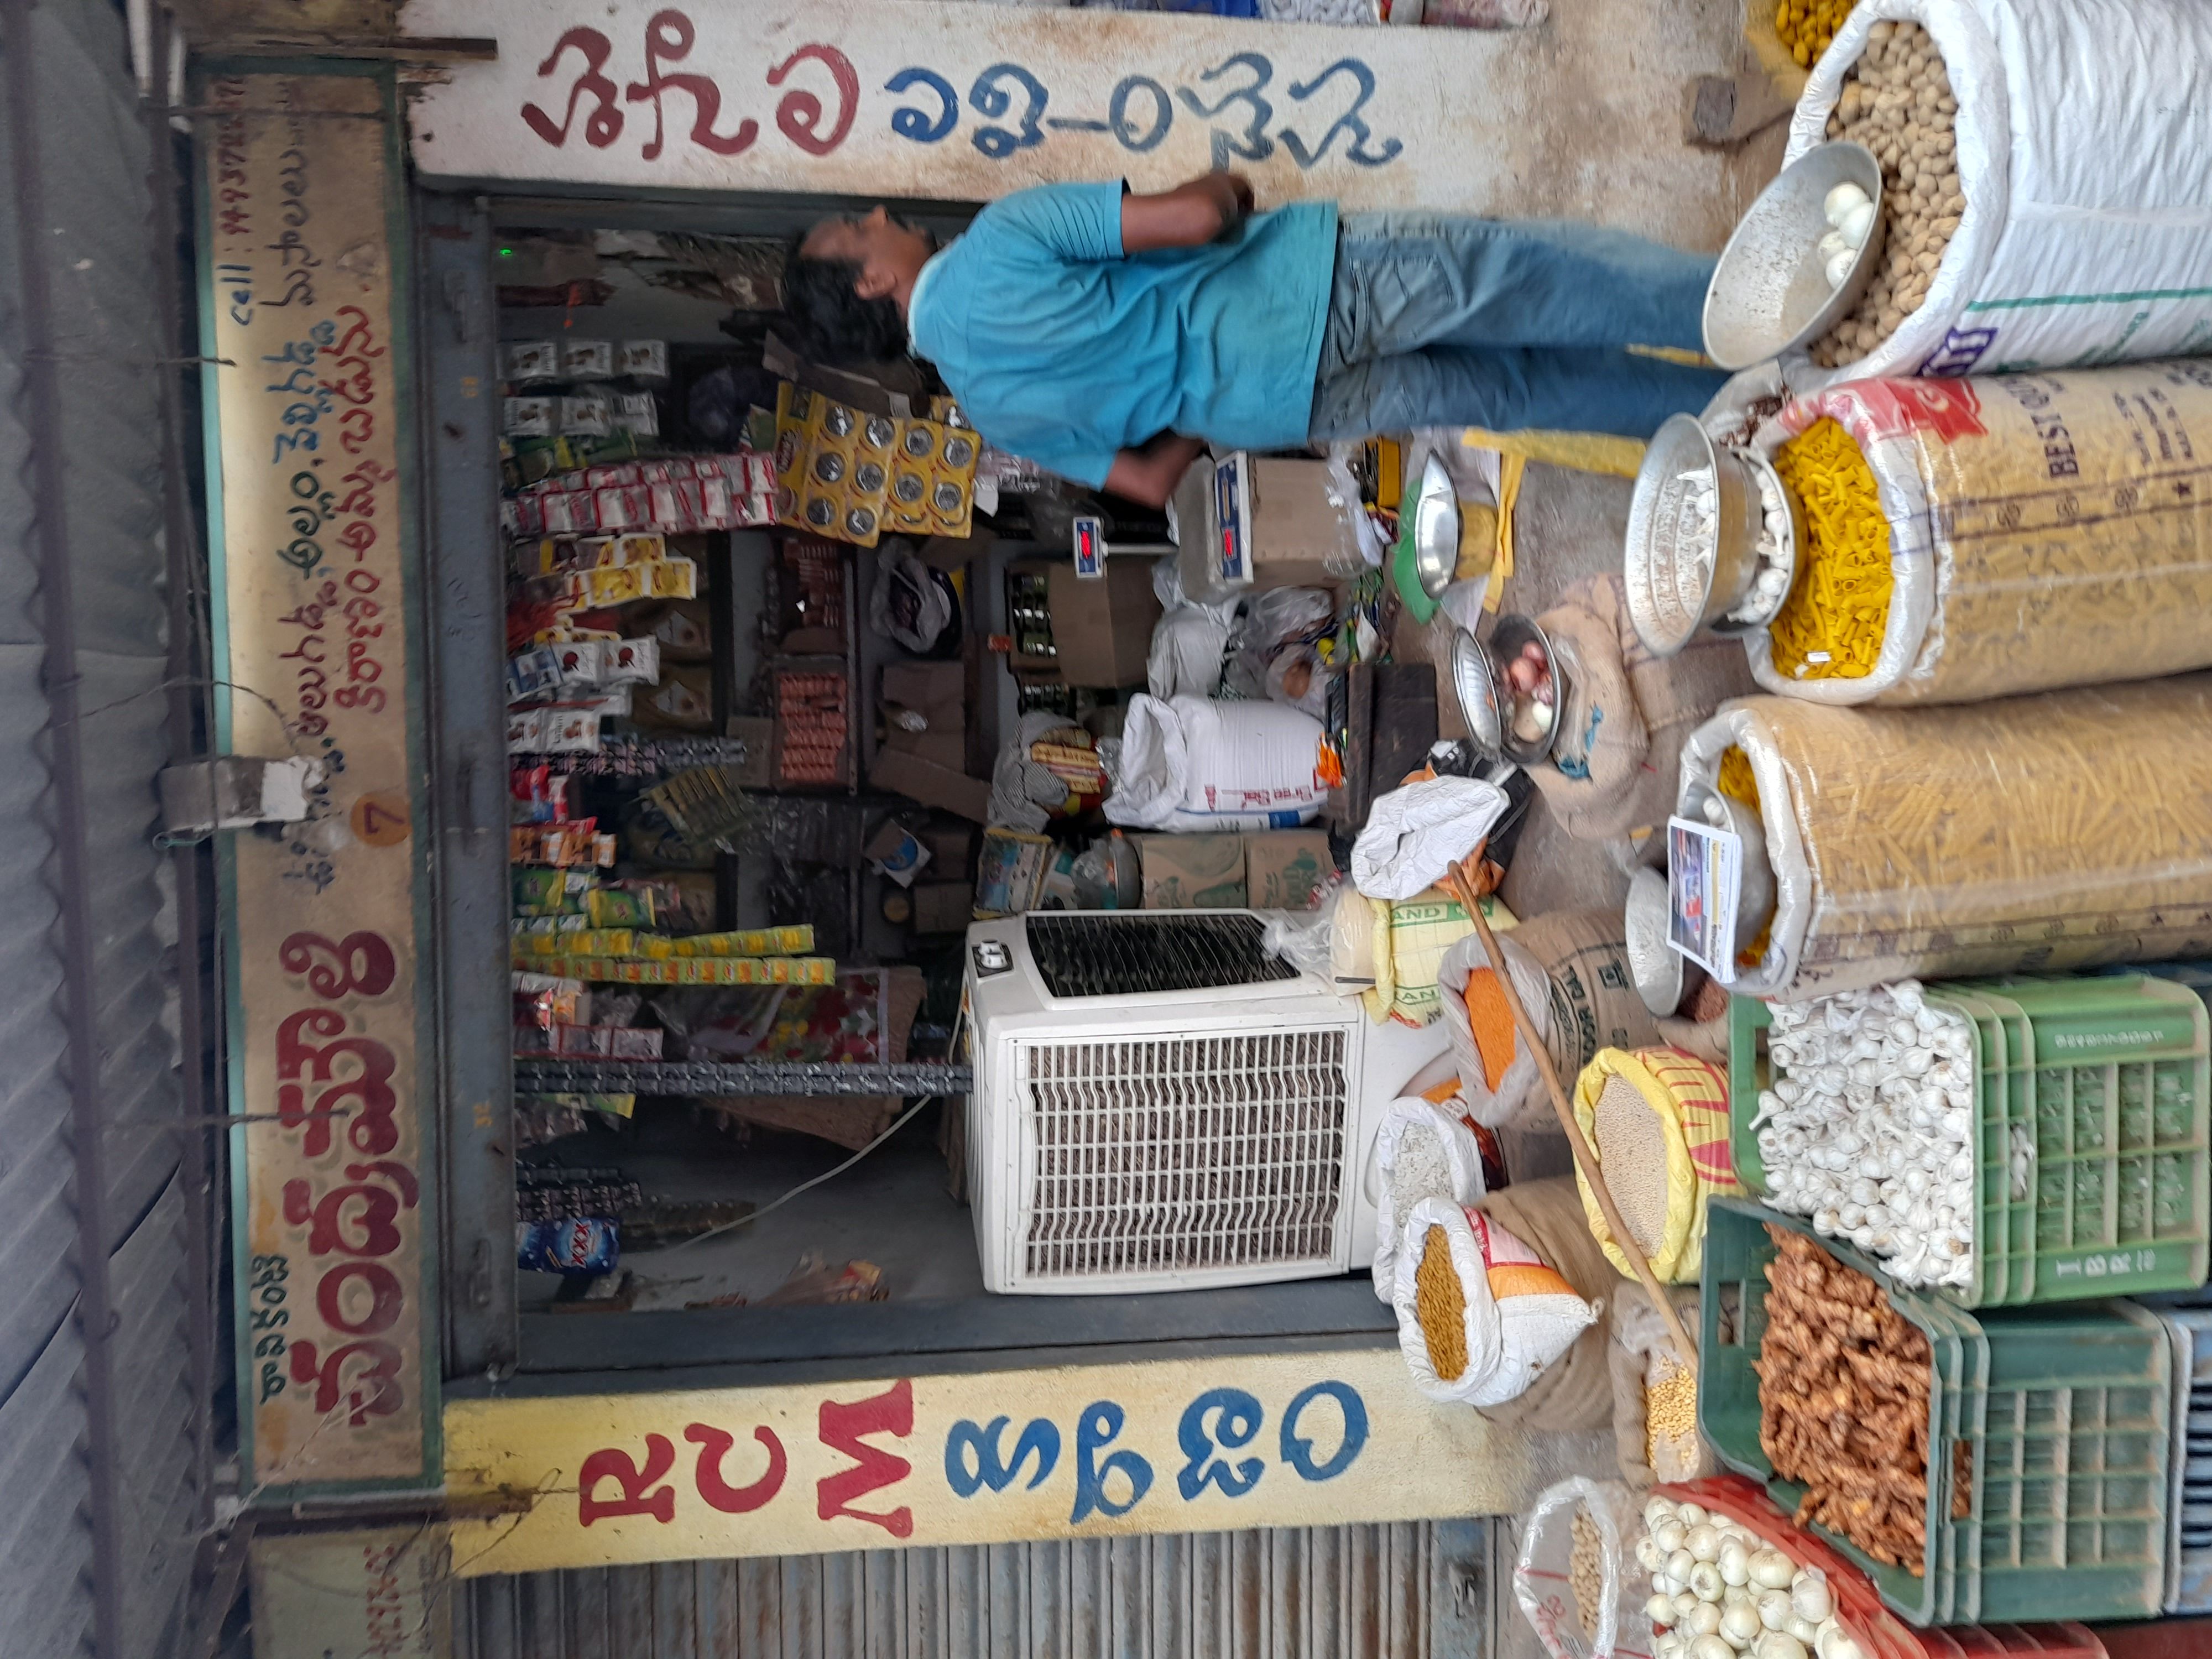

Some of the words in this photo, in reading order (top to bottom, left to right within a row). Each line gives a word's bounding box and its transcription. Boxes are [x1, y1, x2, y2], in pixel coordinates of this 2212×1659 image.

[2030, 412, 2080, 478] BEST
[363, 802, 405, 832] 7
[276, 931, 419, 1426] చంద్రమౌళి
[571, 1220, 591, 1266] XXX
[578, 1378, 914, 1537] RCM
